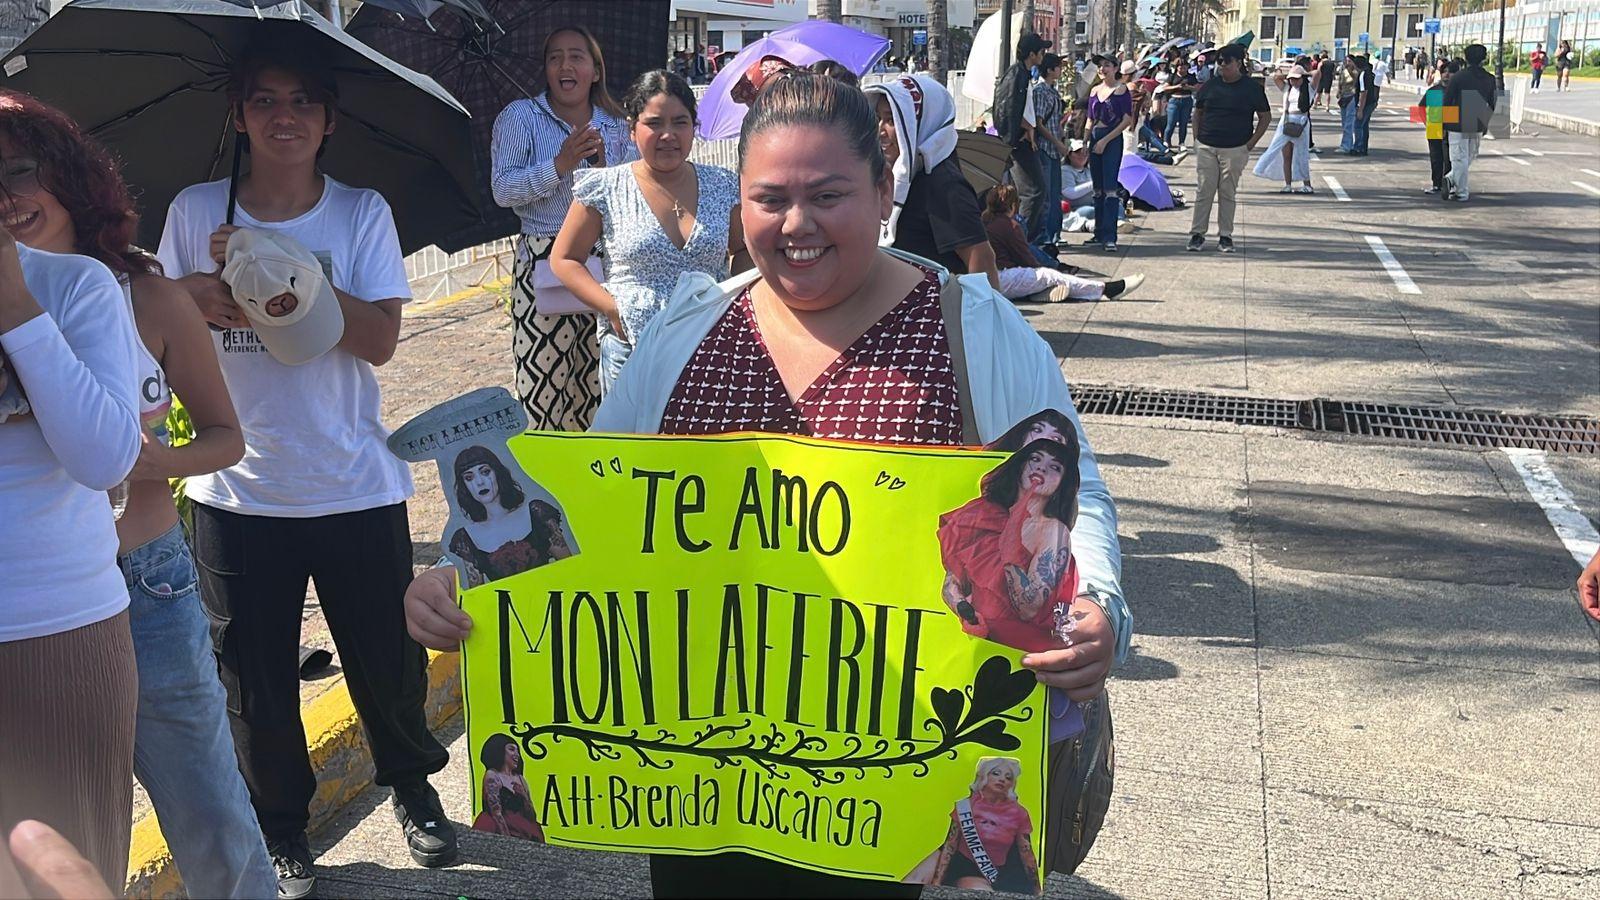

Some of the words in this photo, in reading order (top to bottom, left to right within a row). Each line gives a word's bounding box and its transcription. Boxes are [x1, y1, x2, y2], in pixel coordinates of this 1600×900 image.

[495, 589, 658, 726] MON
[608, 773, 720, 830] Brenda
[737, 768, 883, 848] Uscanga
[959, 811, 985, 854] FEMME
